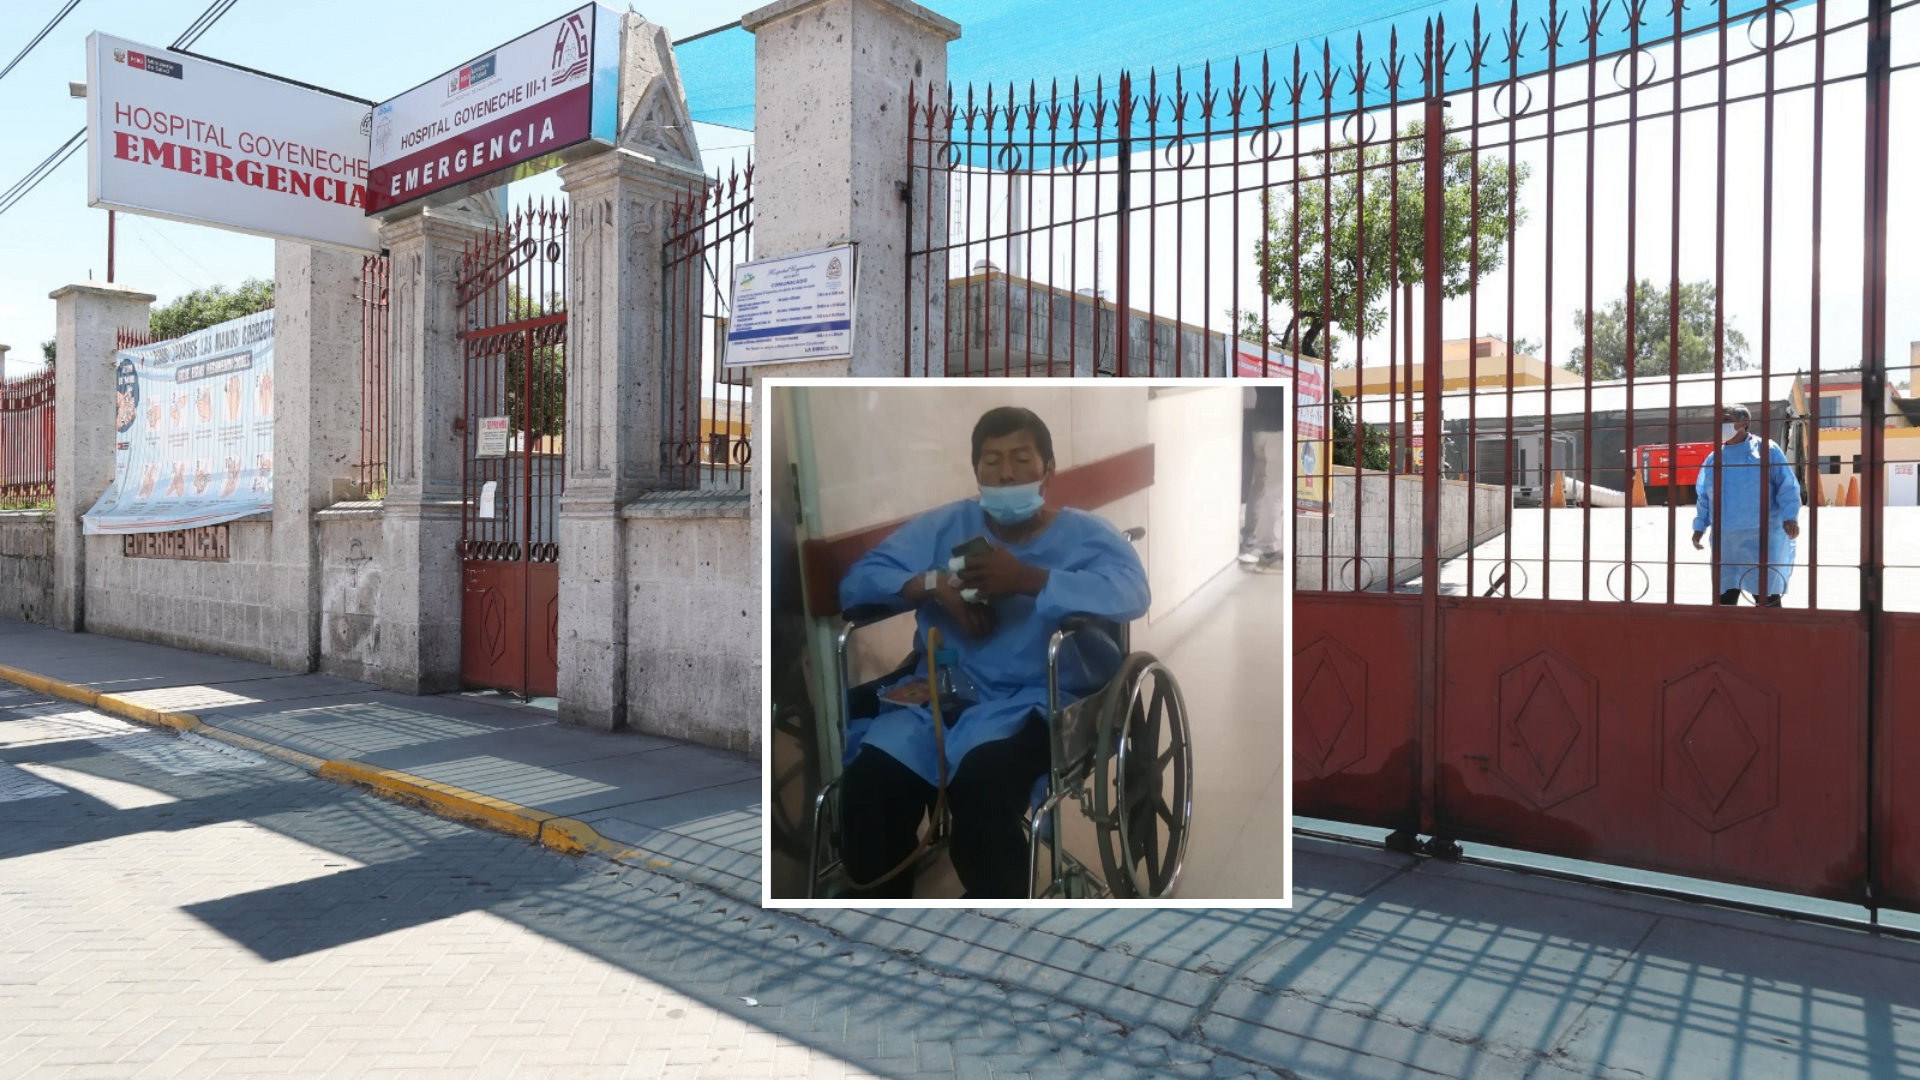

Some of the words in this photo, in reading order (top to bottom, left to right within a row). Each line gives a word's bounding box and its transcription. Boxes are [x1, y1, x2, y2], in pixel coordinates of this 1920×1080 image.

[115, 102, 232, 149] HOSPITAL
[239, 132, 368, 180] GOYENECHE
[401, 119, 450, 150] HOSPITAL
[455, 86, 522, 126] GOYENECHE
[526, 76, 547, 99] III-1
[113, 131, 367, 209] EMERGENCIA
[391, 117, 555, 196] EMERGENCIA
[771, 279, 808, 288] COMUNICADO
[200, 335, 212, 355] LAS
[215, 328, 239, 352] MANOS
[125, 526, 227, 557] EMERGENCIA
